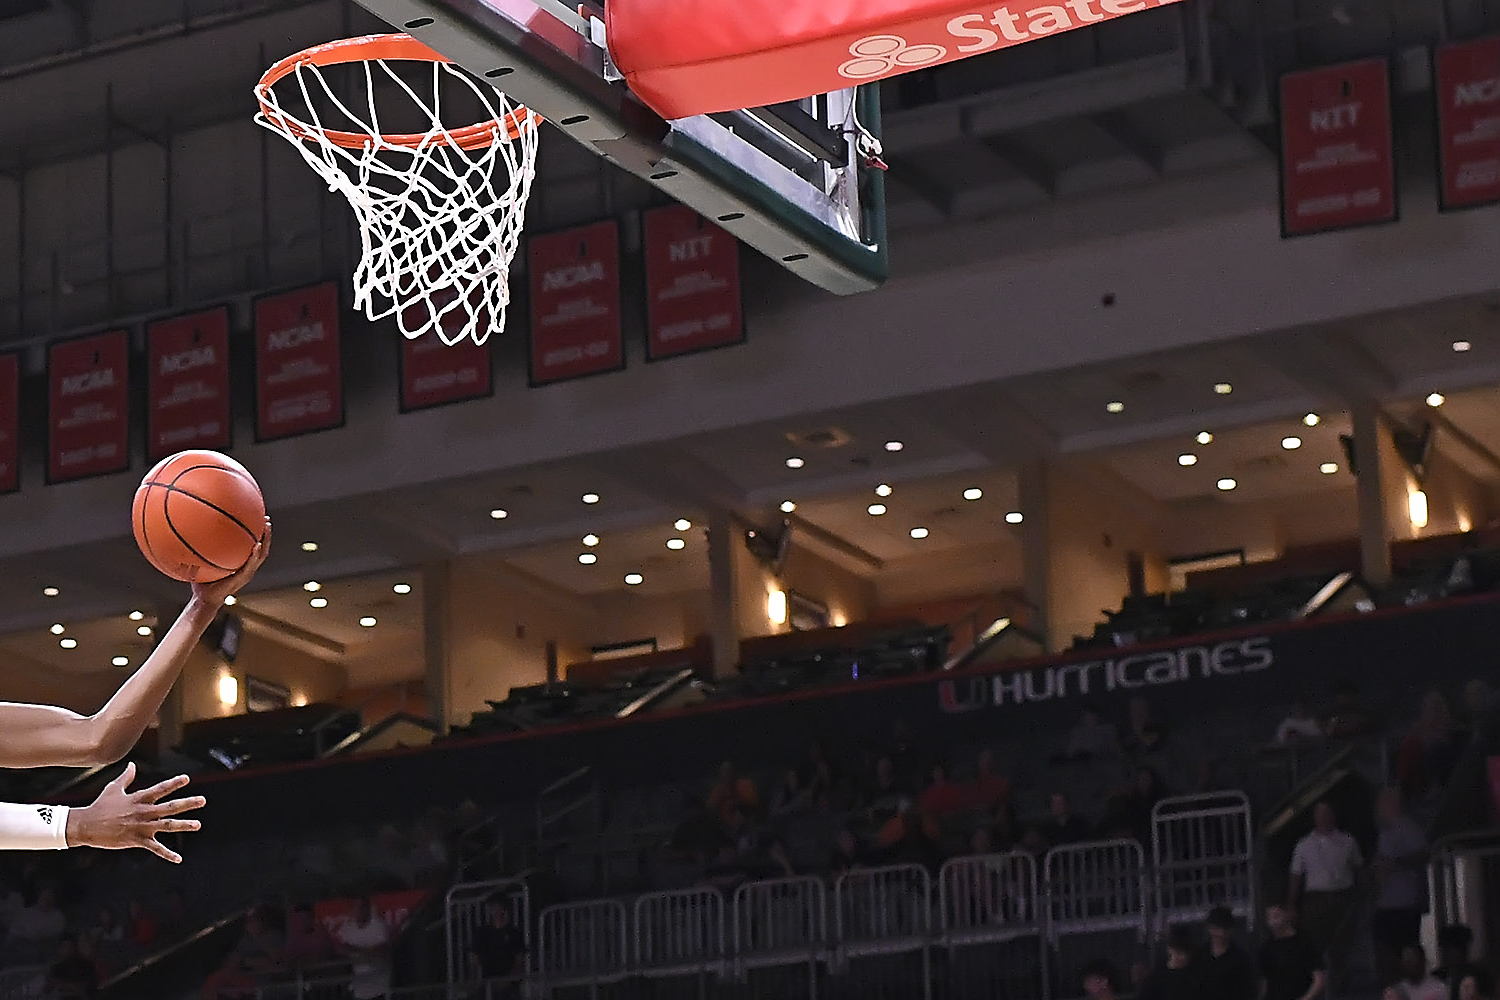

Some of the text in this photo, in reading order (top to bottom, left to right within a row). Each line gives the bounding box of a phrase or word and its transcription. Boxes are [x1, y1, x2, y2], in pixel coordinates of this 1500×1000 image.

[1308, 103, 1363, 133] NIT
[669, 236, 715, 262] NIT
[992, 637, 1274, 707] Hurricanes
